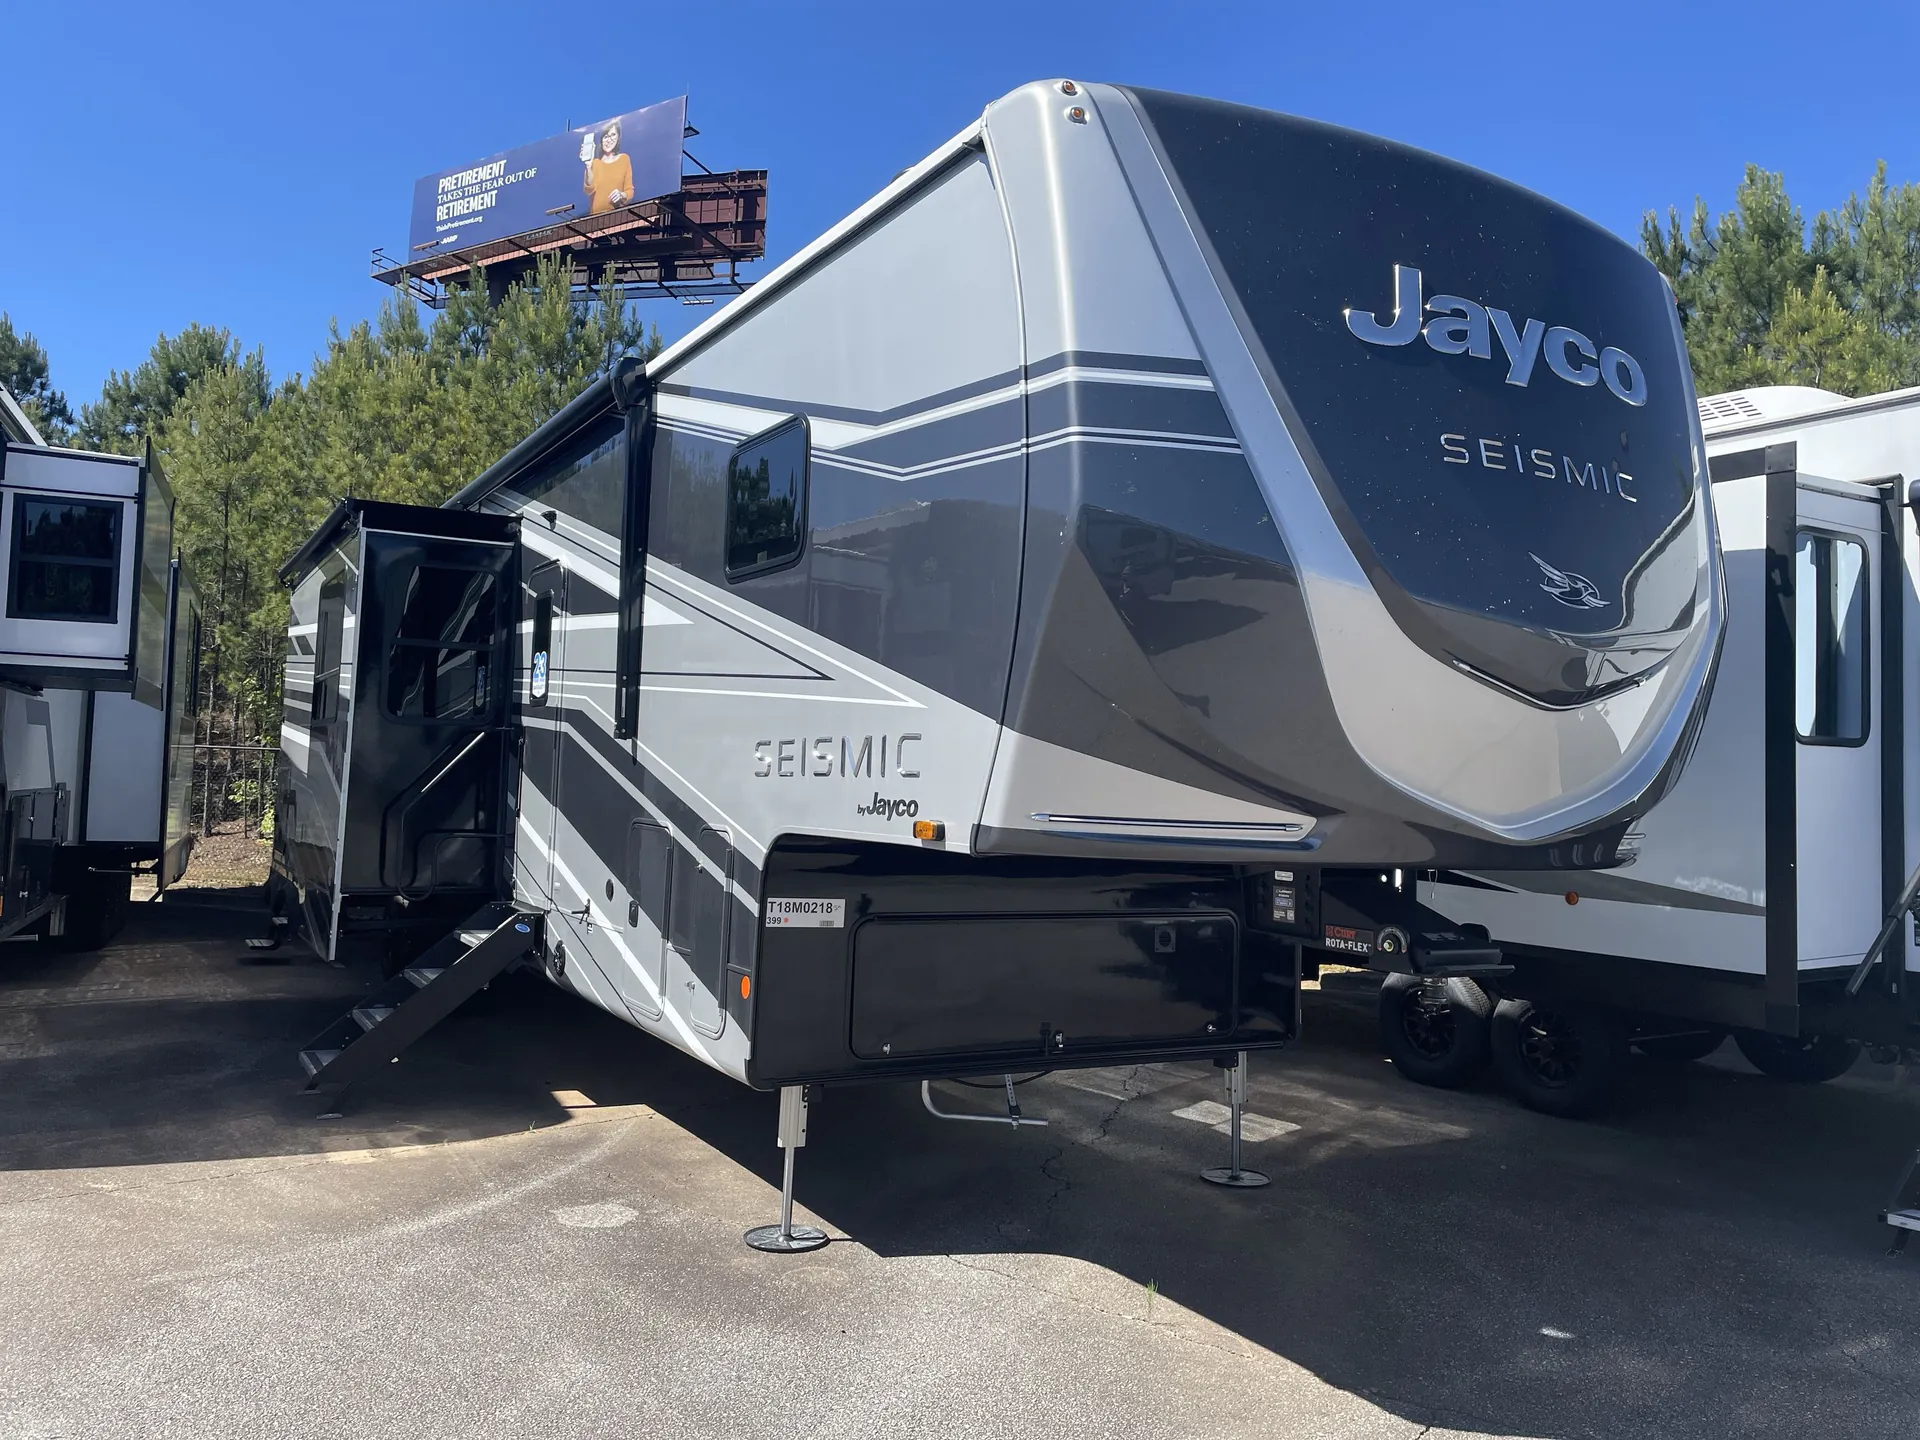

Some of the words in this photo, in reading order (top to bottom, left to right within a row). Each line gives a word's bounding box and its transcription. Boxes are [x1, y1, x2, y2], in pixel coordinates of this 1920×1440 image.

[437, 189, 463, 205] TAKES
[463, 184, 482, 197] THE
[482, 177, 504, 192] FEAR
[504, 171, 524, 185] OUT
[524, 167, 538, 179] OF
[438, 159, 507, 194] PRETIREMENT
[436, 190, 498, 222] RETIREMENT
[1342, 263, 1648, 407] Jayco
[1439, 432, 1638, 503] SEISMIC
[754, 732, 923, 779] SEISMIC
[857, 804, 866, 816] by
[866, 791, 919, 821] Jayco
[766, 916, 782, 925] 399
[768, 901, 833, 914] T18M0218
[1325, 937, 1369, 953] ROTA-FLEX
